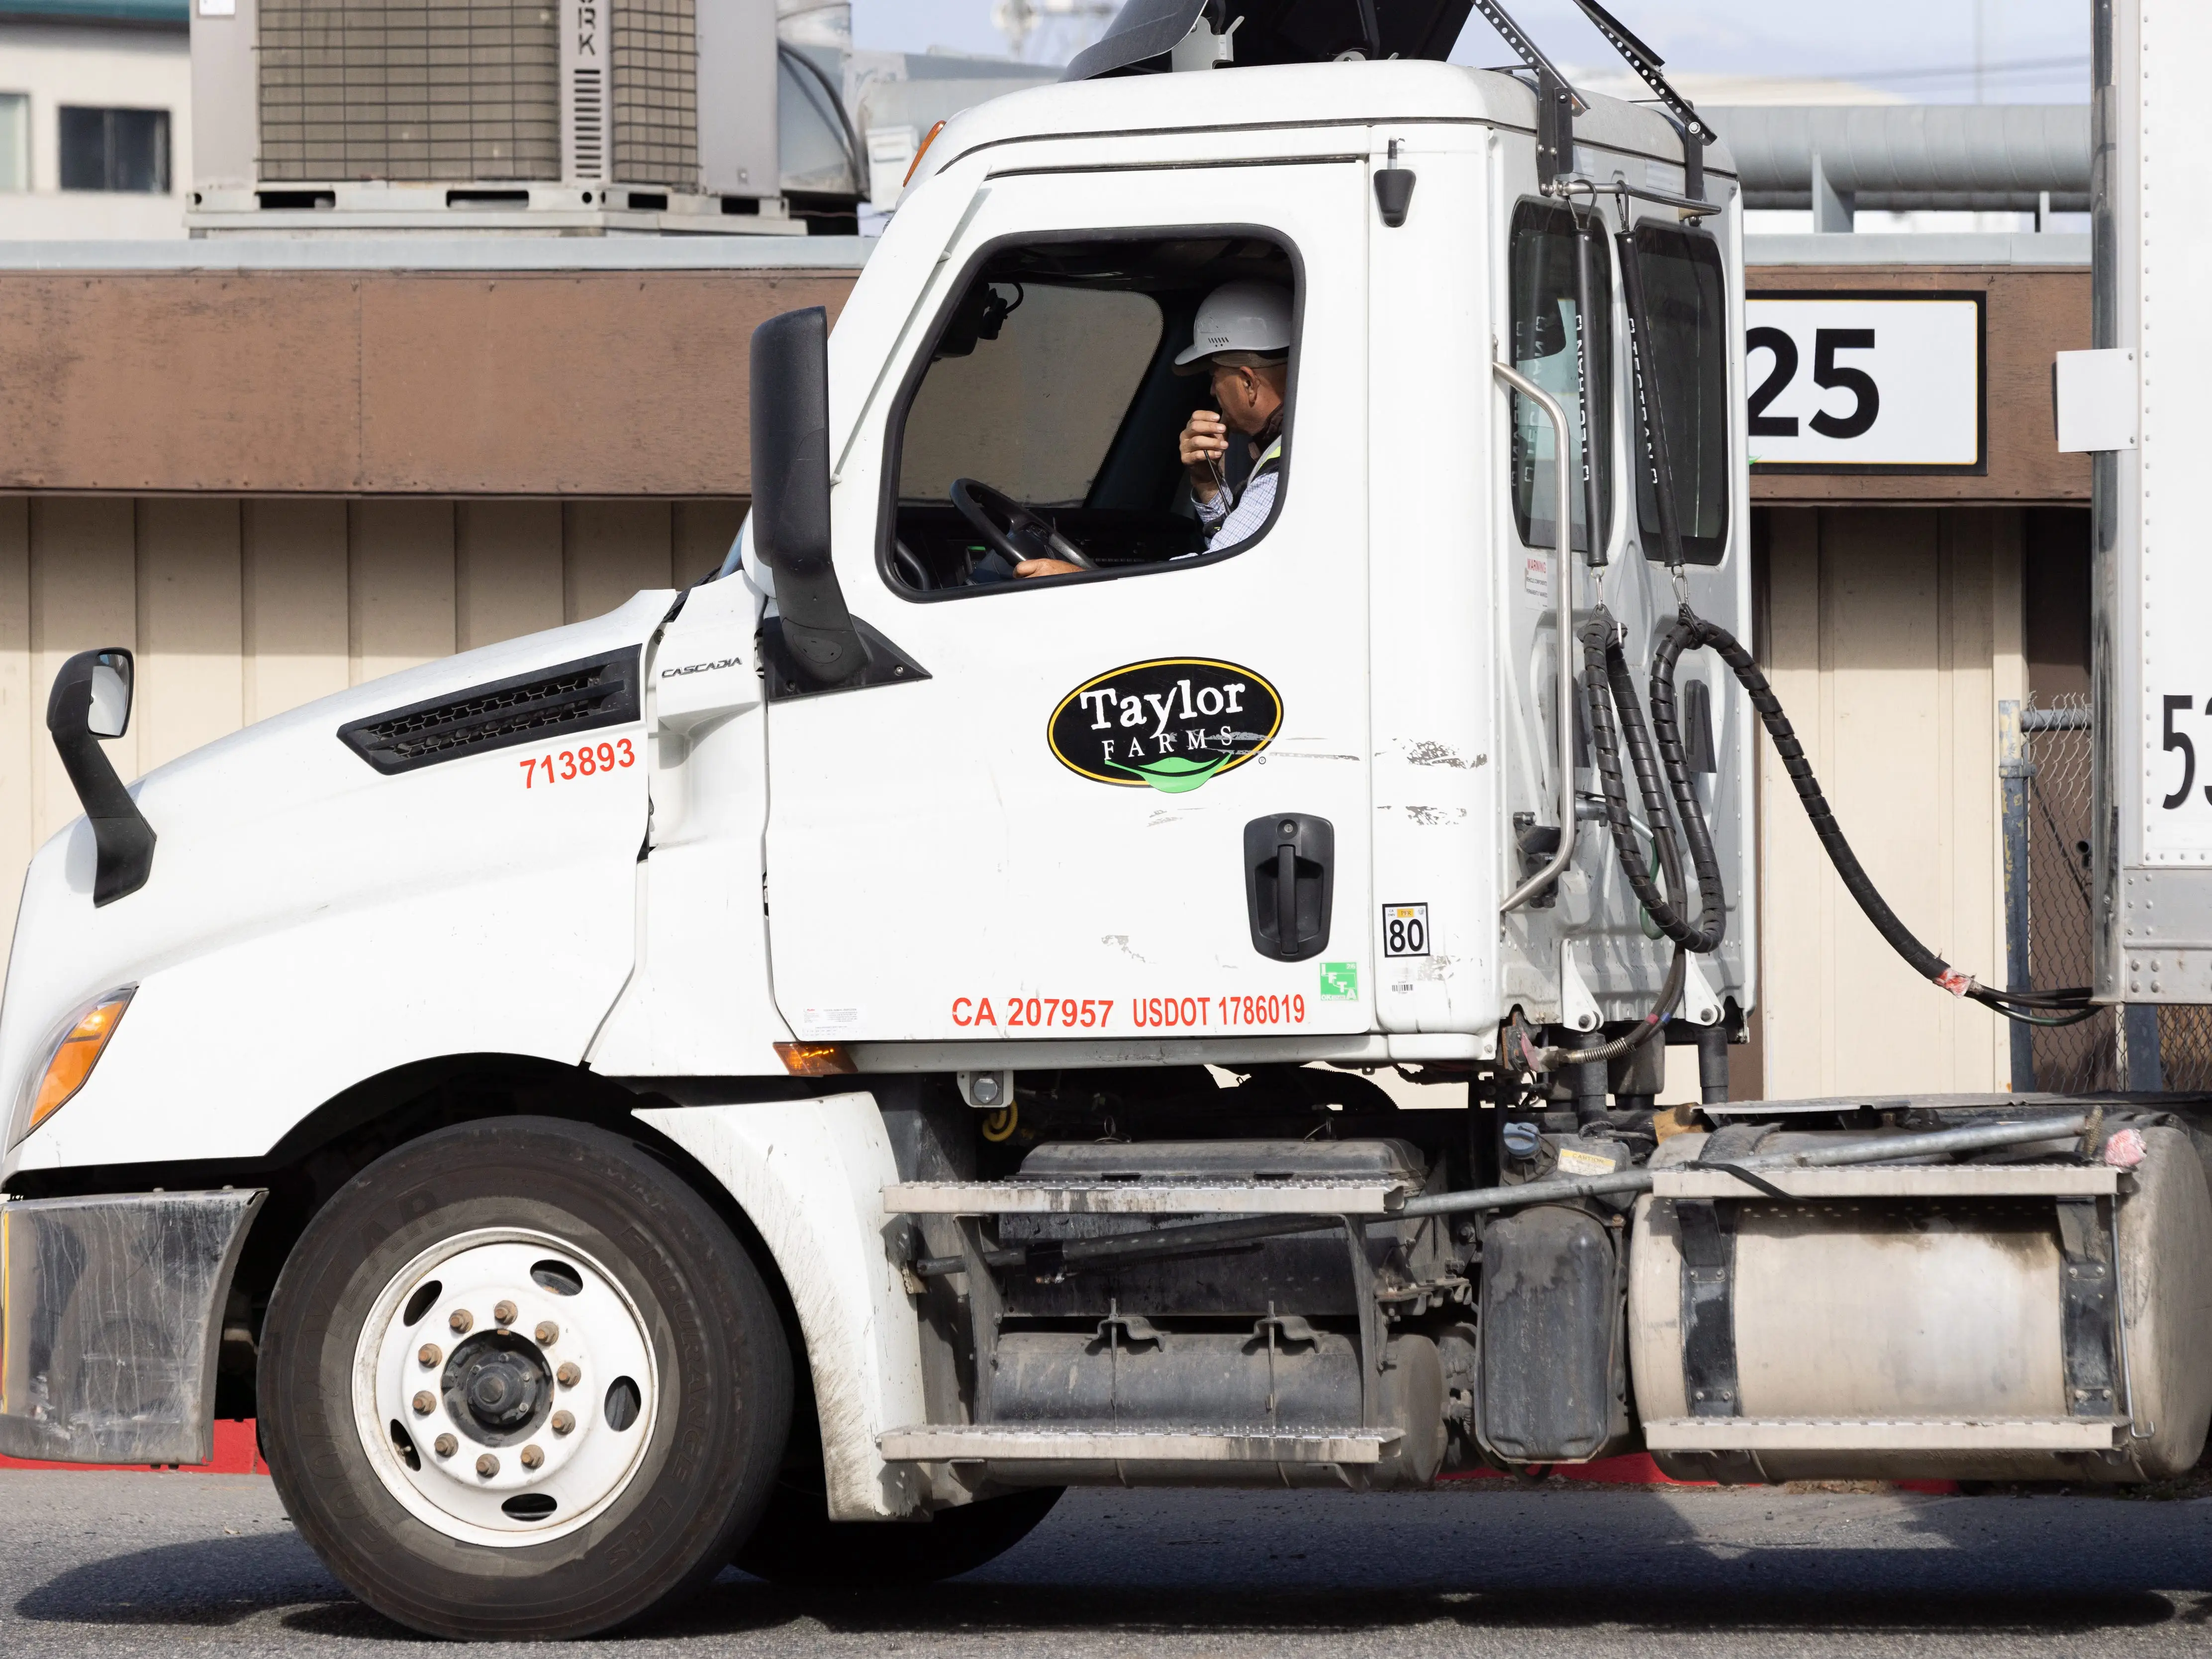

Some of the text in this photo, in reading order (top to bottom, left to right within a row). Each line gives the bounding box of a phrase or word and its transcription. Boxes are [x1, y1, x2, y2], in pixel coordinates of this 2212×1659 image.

[1745, 326, 1880, 439] 25
[1527, 558, 1546, 573] WARNING
[662, 657, 743, 679] CASCADIA
[1080, 680, 1245, 739] Taylor
[1102, 725, 1232, 760] FARMS
[2162, 694, 2212, 810] 5
[520, 738, 635, 788] 713893
[1390, 919, 1424, 952] 80
[952, 994, 1305, 1027] CA 207957 USDOT 1786019
[1573, 1154, 1604, 1163] CAUTION
